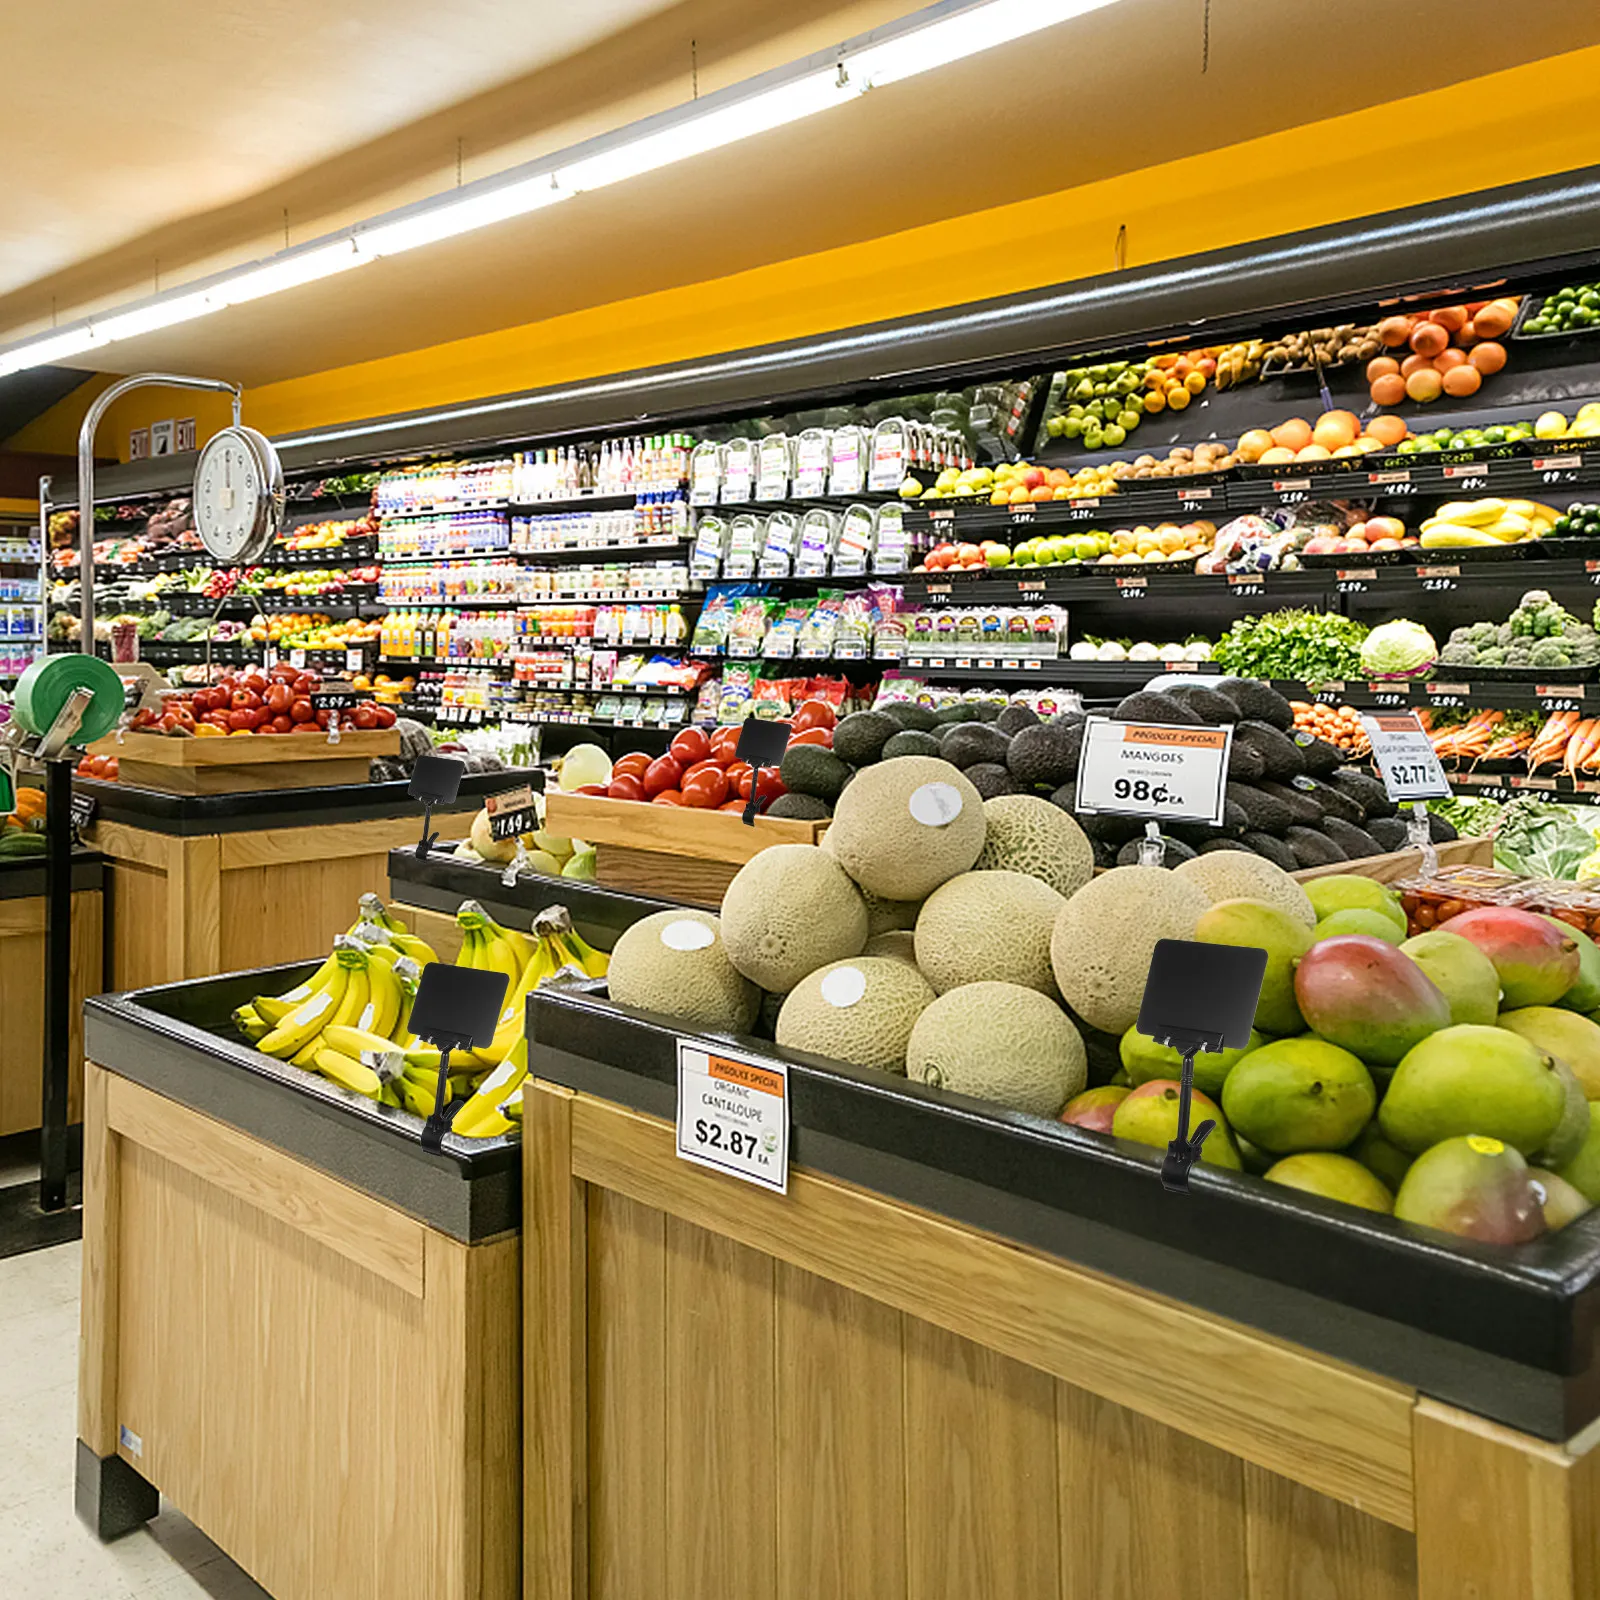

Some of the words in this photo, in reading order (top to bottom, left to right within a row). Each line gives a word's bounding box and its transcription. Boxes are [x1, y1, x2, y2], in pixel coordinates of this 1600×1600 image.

[226, 531, 232, 545] 5
[1121, 750, 1185, 764] MANGOES
[701, 1093, 763, 1123] CANTALOUPE
[695, 1117, 758, 1160] $2.87
